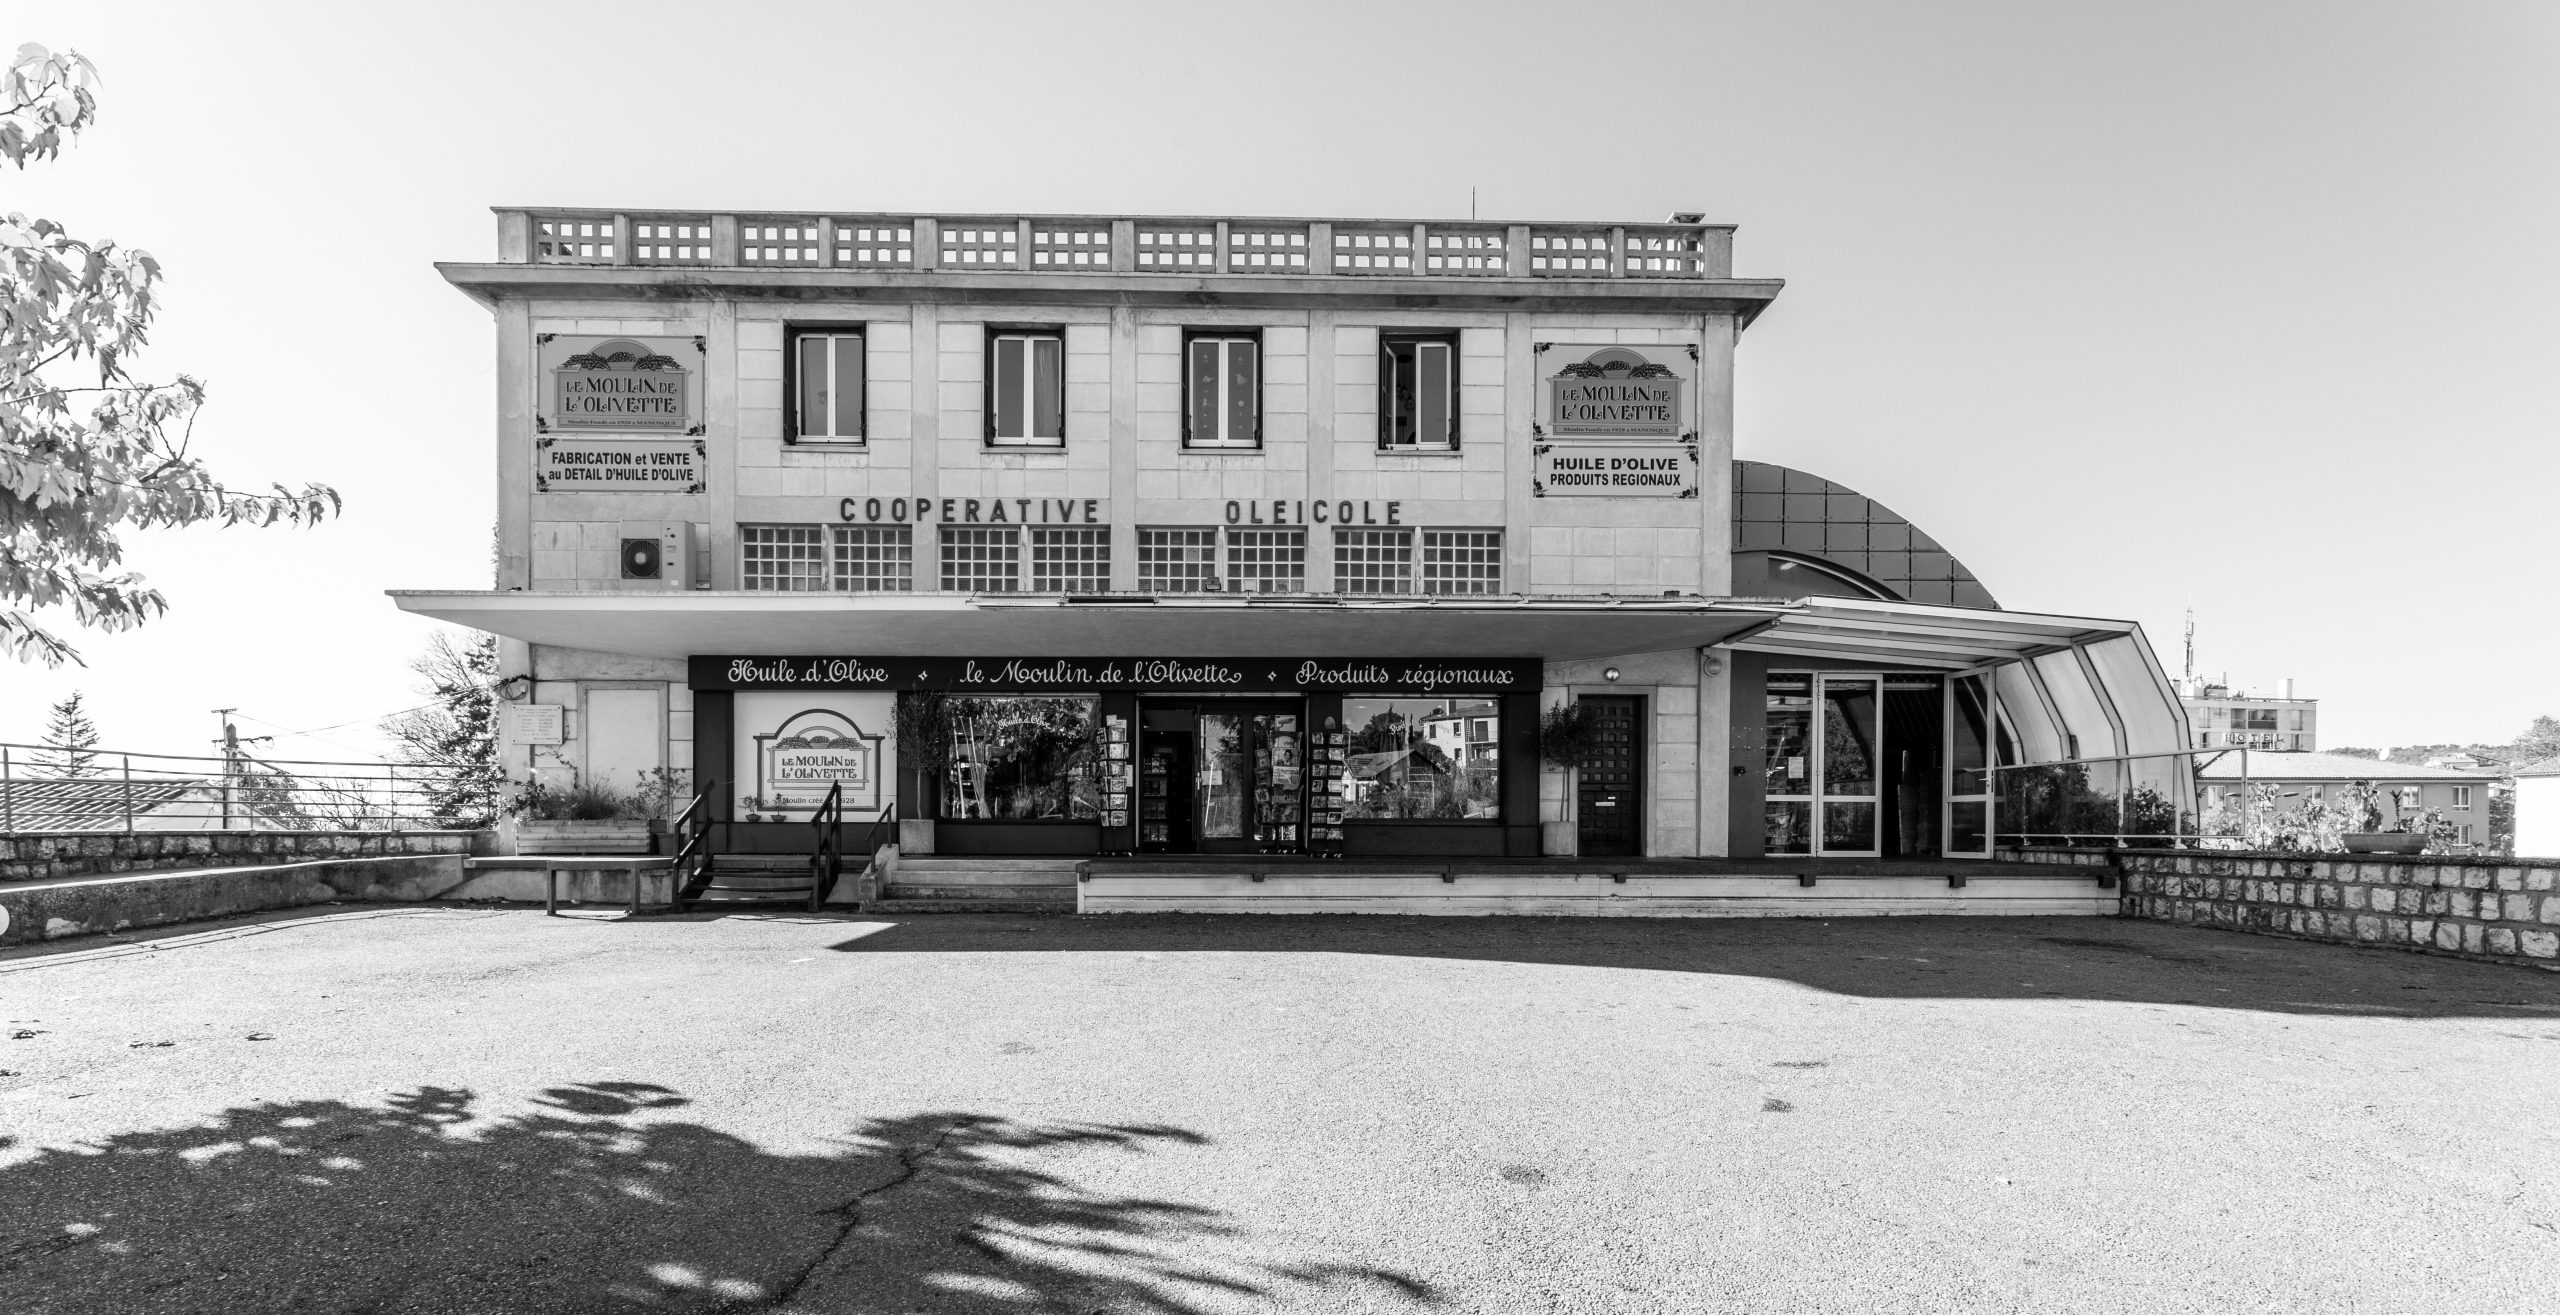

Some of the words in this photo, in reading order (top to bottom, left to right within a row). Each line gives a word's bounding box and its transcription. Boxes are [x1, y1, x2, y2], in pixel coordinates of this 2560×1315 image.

[566, 381, 584, 393] LE
[585, 377, 656, 394] MOULIN
[659, 382, 677, 394] DE
[1561, 389, 1580, 401] LE
[1580, 385, 1651, 402] MOULIN
[1653, 390, 1671, 402] DE
[565, 396, 677, 413] L'OLIVETTE
[1561, 404, 1671, 421] L'OLIVETTE
[552, 452, 632, 465] FABRICATION
[635, 453, 647, 465] et
[650, 453, 690, 465] VENTE
[1553, 458, 1605, 470] HUILE
[1611, 458, 1678, 470] D'OLIVE
[548, 470, 562, 481] au
[564, 468, 603, 481] DETAIL
[606, 468, 648, 481] D'HUILE
[651, 468, 694, 481] D'OLIVE
[1550, 473, 1609, 486] PRODUITS
[1612, 473, 1681, 486] REGIONAUX
[839, 497, 1099, 524] COOPERATIVE
[1225, 499, 1401, 525] OLEICOLE
[728, 658, 797, 682] Huile
[800, 659, 889, 683] d'Olive
[959, 660, 985, 683] le
[990, 659, 1092, 683] Moulin
[1095, 662, 1124, 683] de
[1128, 660, 1242, 683] l'Olivette
[1295, 660, 1389, 685] Produits
[1397, 664, 1514, 691] régionaux
[2225, 733, 2284, 742] HOTEL
[781, 758, 795, 767] LE
[796, 756, 843, 767] MOULIN
[844, 759, 857, 767] DE
[781, 768, 857, 779] L'OLIVETTE
